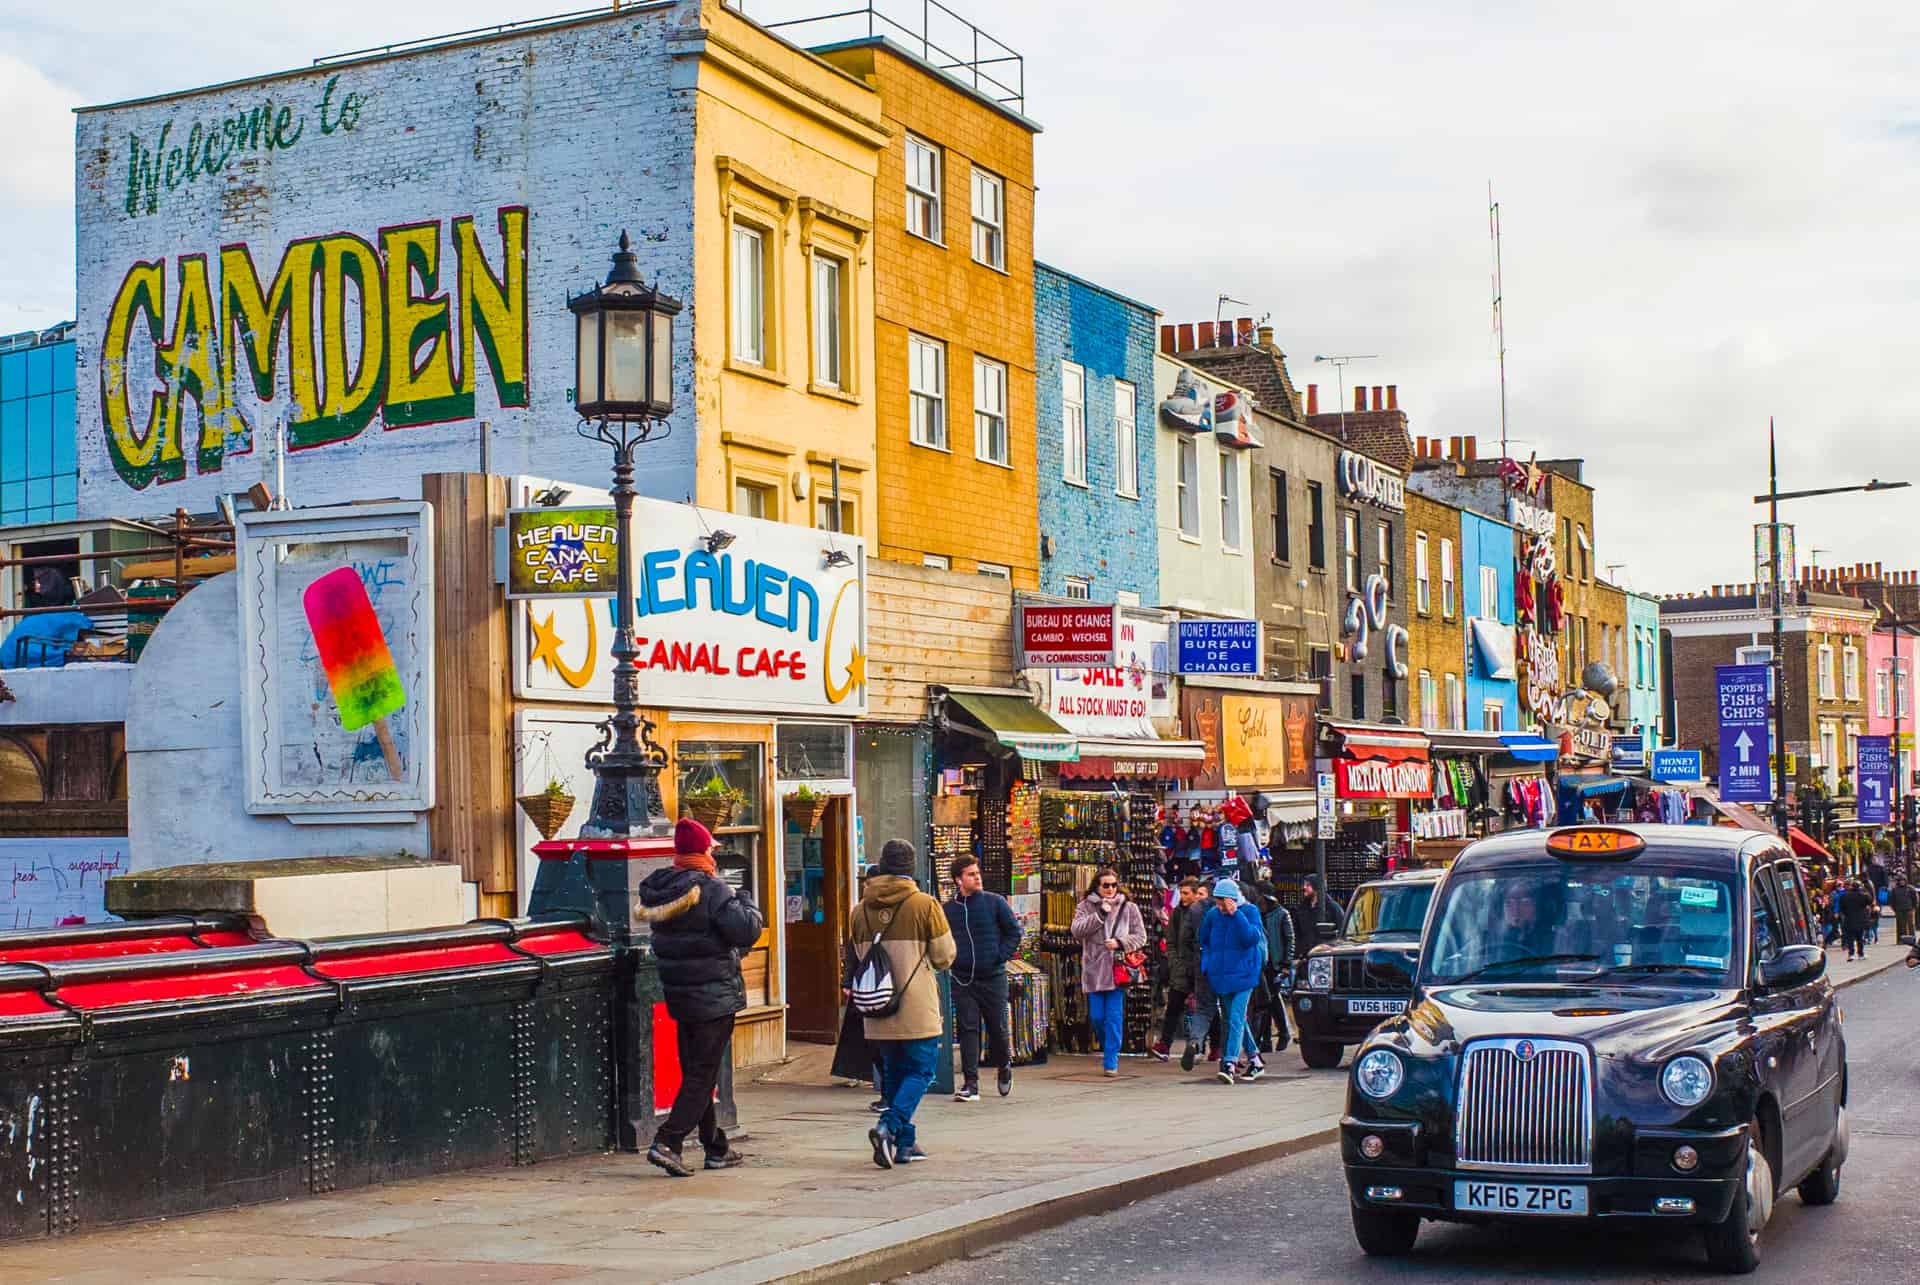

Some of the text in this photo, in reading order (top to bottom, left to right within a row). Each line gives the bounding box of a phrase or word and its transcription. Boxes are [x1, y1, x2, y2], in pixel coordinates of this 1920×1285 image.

[125, 75, 368, 219] Welcome to
[101, 205, 530, 490] CAMDEN
[526, 548, 608, 566] CANAL
[534, 568, 599, 584] CAFE
[1026, 613, 1112, 628] BUREAU DE CHANGE
[1180, 623, 1256, 638] MONEY EXCHANGE
[1031, 632, 1065, 643] CAMBIO
[1072, 632, 1109, 643] WECHSEL
[1184, 640, 1252, 649] BUREAU
[1031, 653, 1107, 664] 0% COMMISSION
[1207, 651, 1229, 661] DE
[736, 647, 807, 681] CAFE
[1183, 663, 1252, 672] CHANGE
[1058, 696, 1146, 718] ALL STOCK MUST GO!
[1720, 694, 1756, 707] FISH
[1721, 706, 1765, 719] CHIPS
[1660, 757, 1696, 766] MONEY
[1858, 753, 1882, 761] FISH
[1657, 766, 1697, 775] CHANGE
[1729, 766, 1760, 777] 2 MIN
[1567, 833, 1622, 849] TAXI
[1352, 1001, 1380, 1012] DV56
[1468, 1183, 1573, 1210] KF16 ZPG
